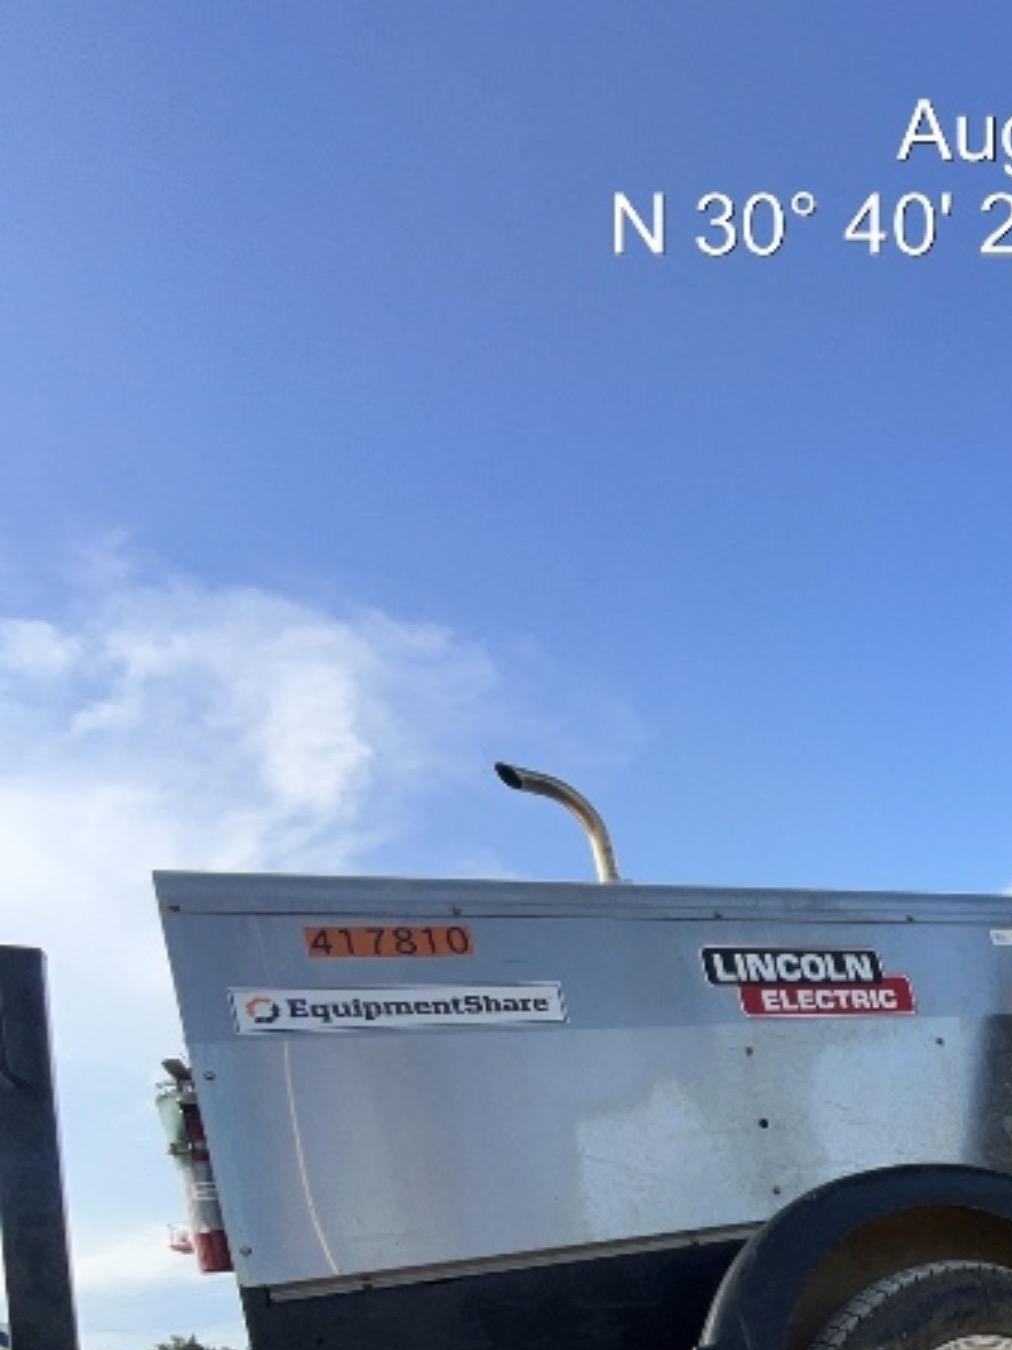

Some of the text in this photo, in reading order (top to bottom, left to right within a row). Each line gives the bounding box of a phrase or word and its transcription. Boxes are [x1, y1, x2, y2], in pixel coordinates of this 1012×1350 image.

[310, 925, 471, 956] 417810
[712, 953, 874, 982] LINCOLN
[286, 994, 550, 1022] EquipmentShare
[760, 988, 899, 1012] ELECTRIC
